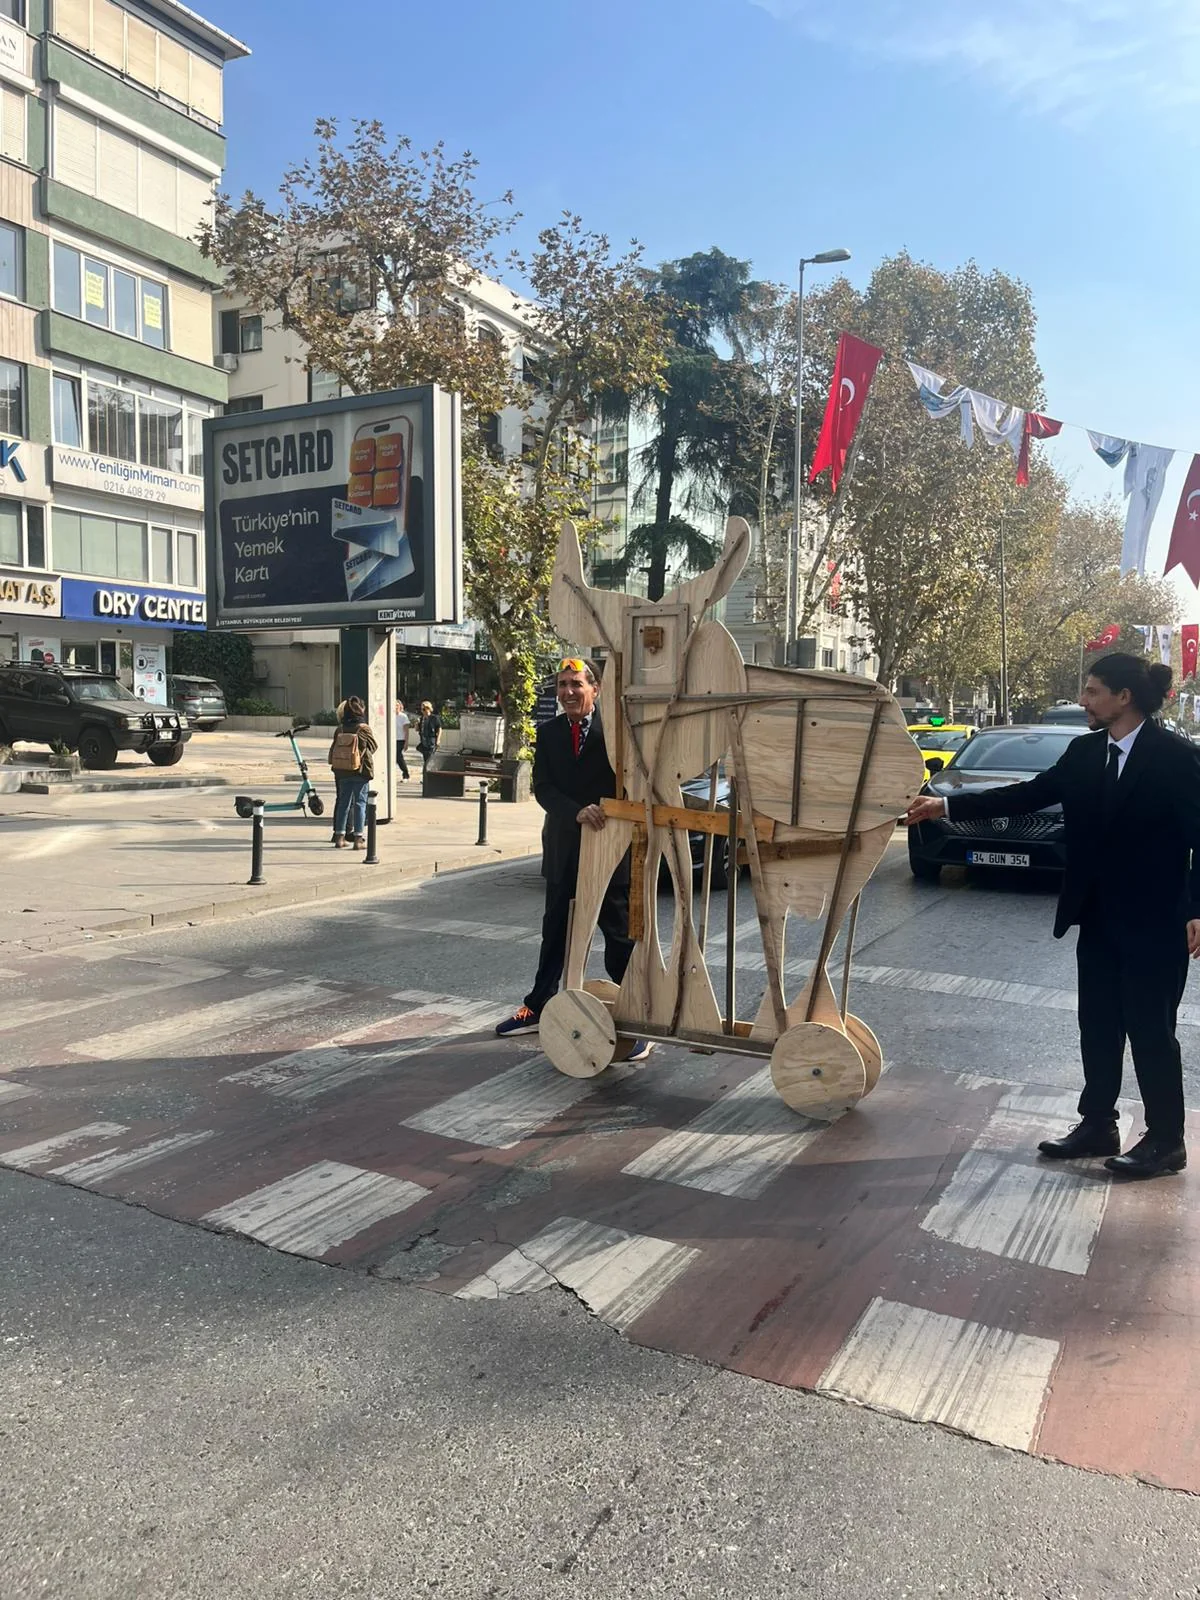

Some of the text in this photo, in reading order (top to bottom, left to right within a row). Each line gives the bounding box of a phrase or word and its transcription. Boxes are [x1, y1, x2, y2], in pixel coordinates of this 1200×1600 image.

[222, 428, 334, 485] SETCARD
[103, 480, 167, 502] 0216 408 29 29
[234, 536, 285, 558] Yemek
[235, 565, 269, 583] Kartı
[98, 589, 140, 616] DRY
[973, 853, 1027, 865] 34 GUN 354
